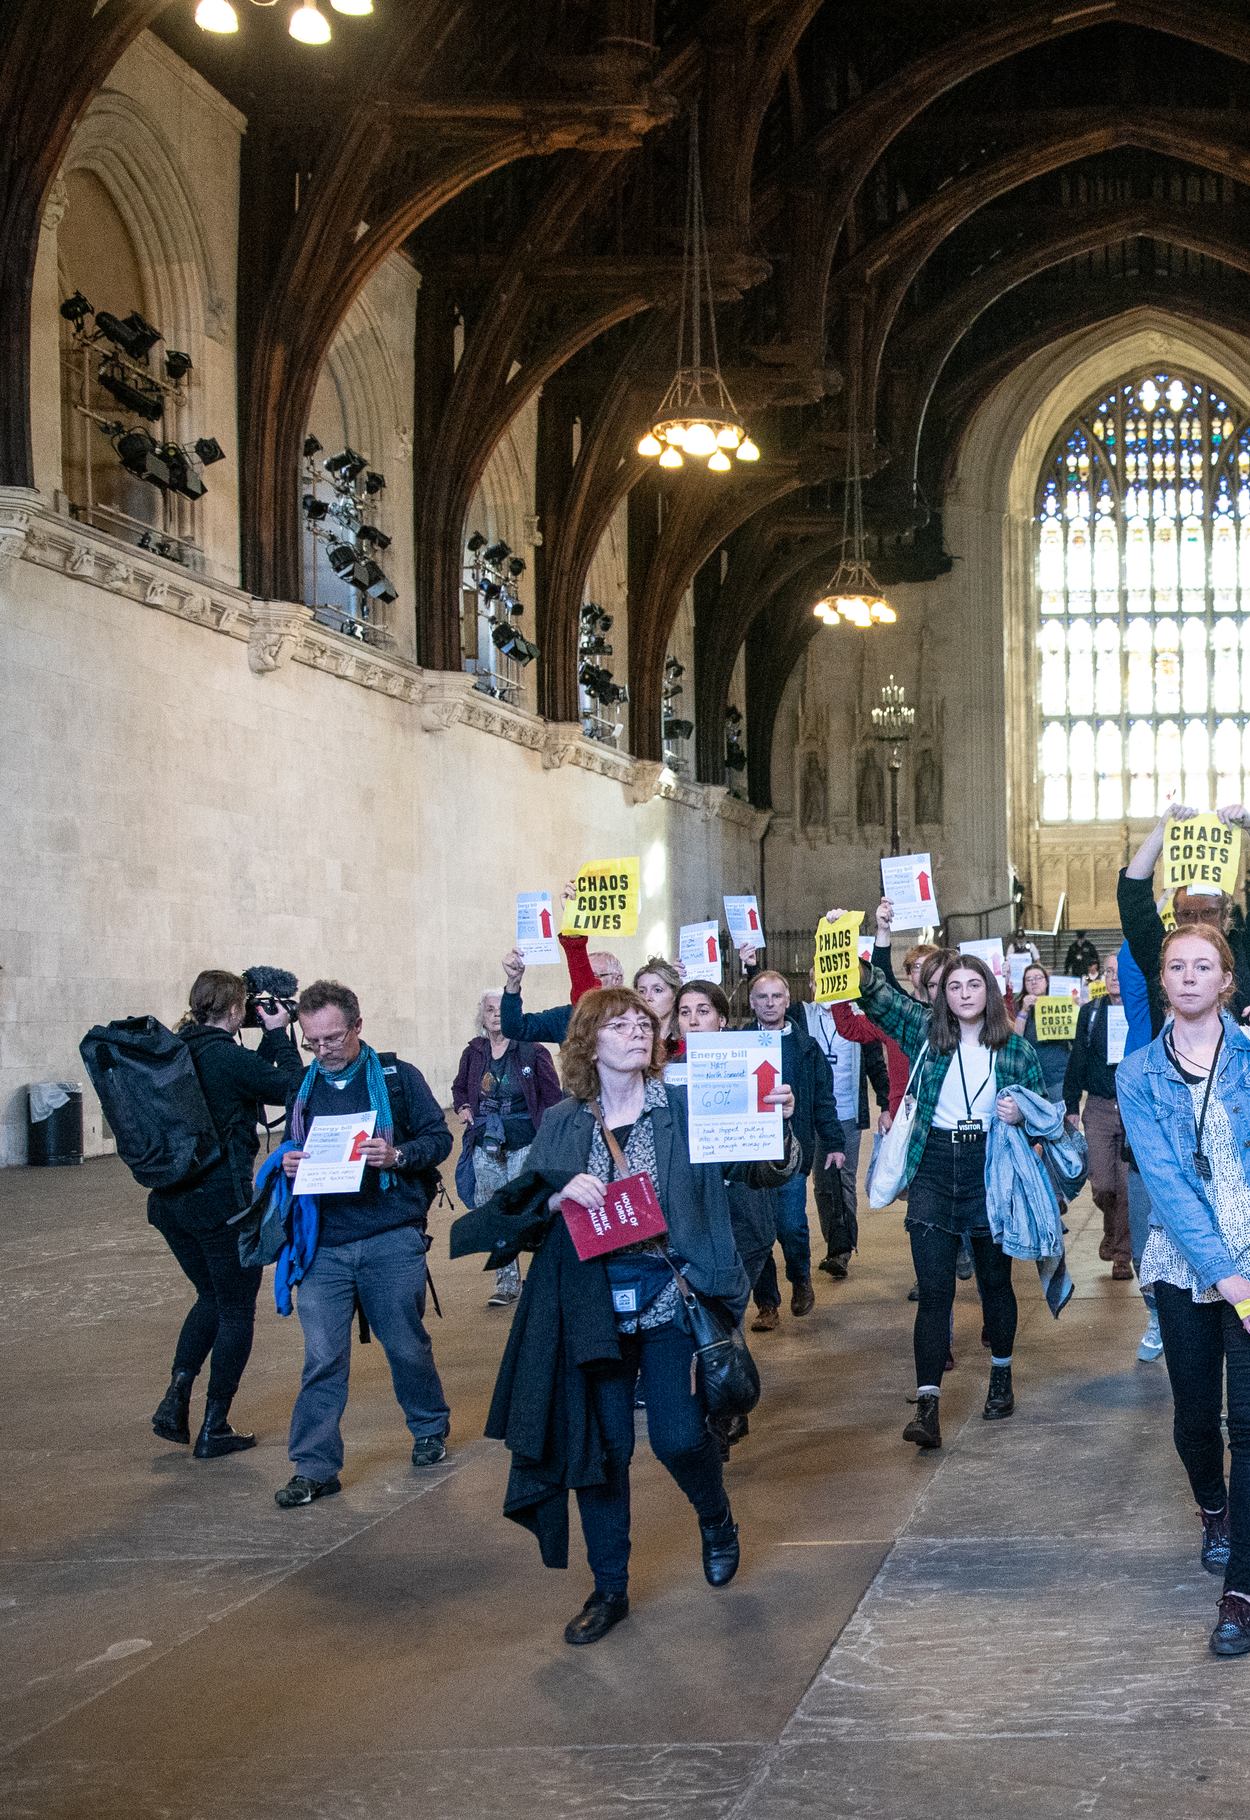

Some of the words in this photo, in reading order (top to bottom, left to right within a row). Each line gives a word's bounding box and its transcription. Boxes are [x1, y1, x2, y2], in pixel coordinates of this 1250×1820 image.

[1170, 825, 1233, 845] CHAOS
[1170, 844, 1229, 864] COSTS
[1171, 863, 1222, 883] LIVES
[577, 874, 629, 892] CHAOS
[577, 894, 627, 912] COSTS
[573, 913, 622, 930] LIVES
[818, 928, 851, 952] CHAOS
[819, 951, 850, 974] COSTS
[820, 974, 848, 995] LIVES
[1040, 1004, 1073, 1014] CHAOS
[1041, 1015, 1072, 1026] COSTS
[1042, 1026, 1070, 1036] LIVES
[690, 1051, 728, 1060] Energy
[731, 1050, 747, 1058] bill
[702, 1089, 731, 1108] 60%
[718, 1142, 737, 1152] enough
[742, 1142, 760, 1151] money
[598, 1206, 612, 1232] PUBLIC
[613, 1201, 629, 1225] LORDS
[620, 1192, 635, 1217] HOUSE
[629, 1216, 639, 1227] OF
